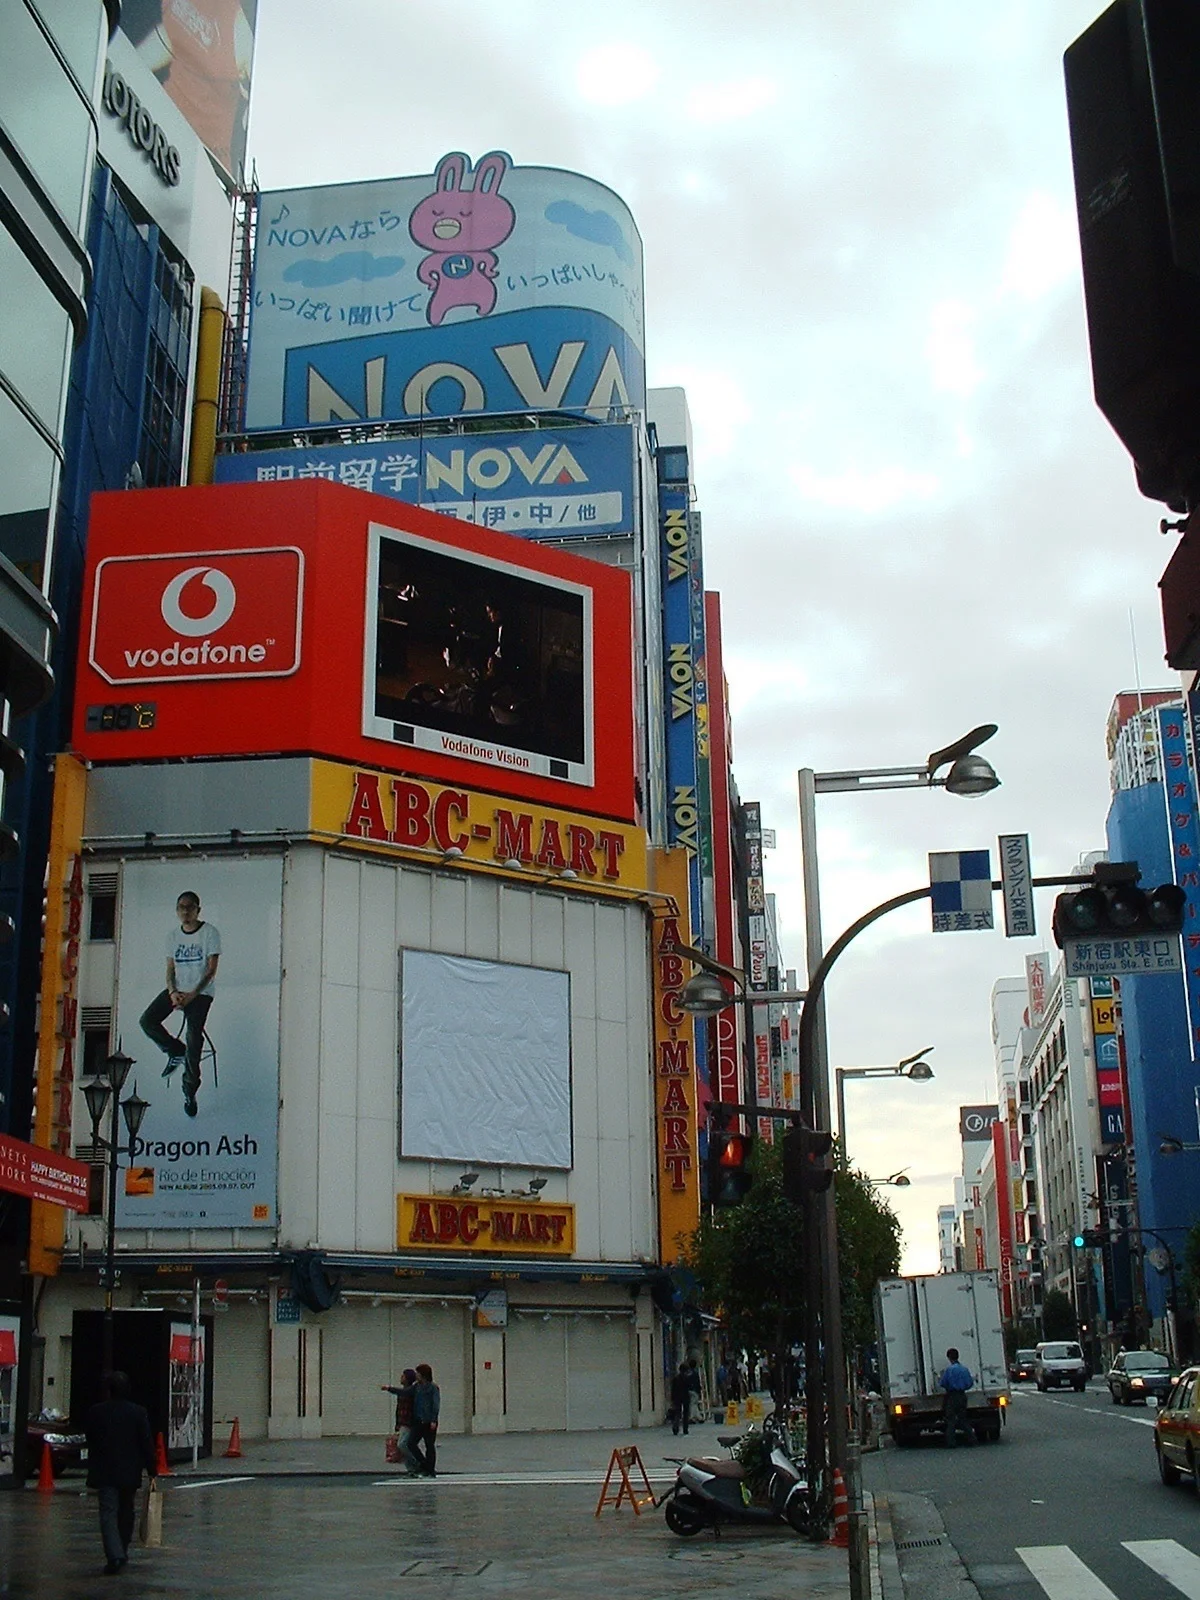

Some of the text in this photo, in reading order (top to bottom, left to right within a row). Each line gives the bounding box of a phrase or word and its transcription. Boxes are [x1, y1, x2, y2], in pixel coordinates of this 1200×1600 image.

[103, 72, 180, 187] OTORS
[267, 210, 401, 249] NOVAなら
[254, 291, 424, 326] いっぱい聞けて
[306, 340, 634, 425] NOVA
[426, 444, 588, 496] NOVA
[664, 509, 688, 581] NOVA
[124, 643, 266, 668] vodafone
[668, 643, 693, 720] NOVA
[441, 736, 530, 767] Vodafone Vision
[344, 771, 626, 880] ABC-MART
[932, 911, 993, 930] 時差式
[1072, 961, 1117, 973] Shinjuku
[1075, 940, 1170, 961] 新宿駅東口
[658, 918, 691, 1191] ABC-MART
[128, 1134, 258, 1162] Dragon Ash
[181, 1168, 198, 1181] de
[408, 1201, 568, 1244] ABC-MART
